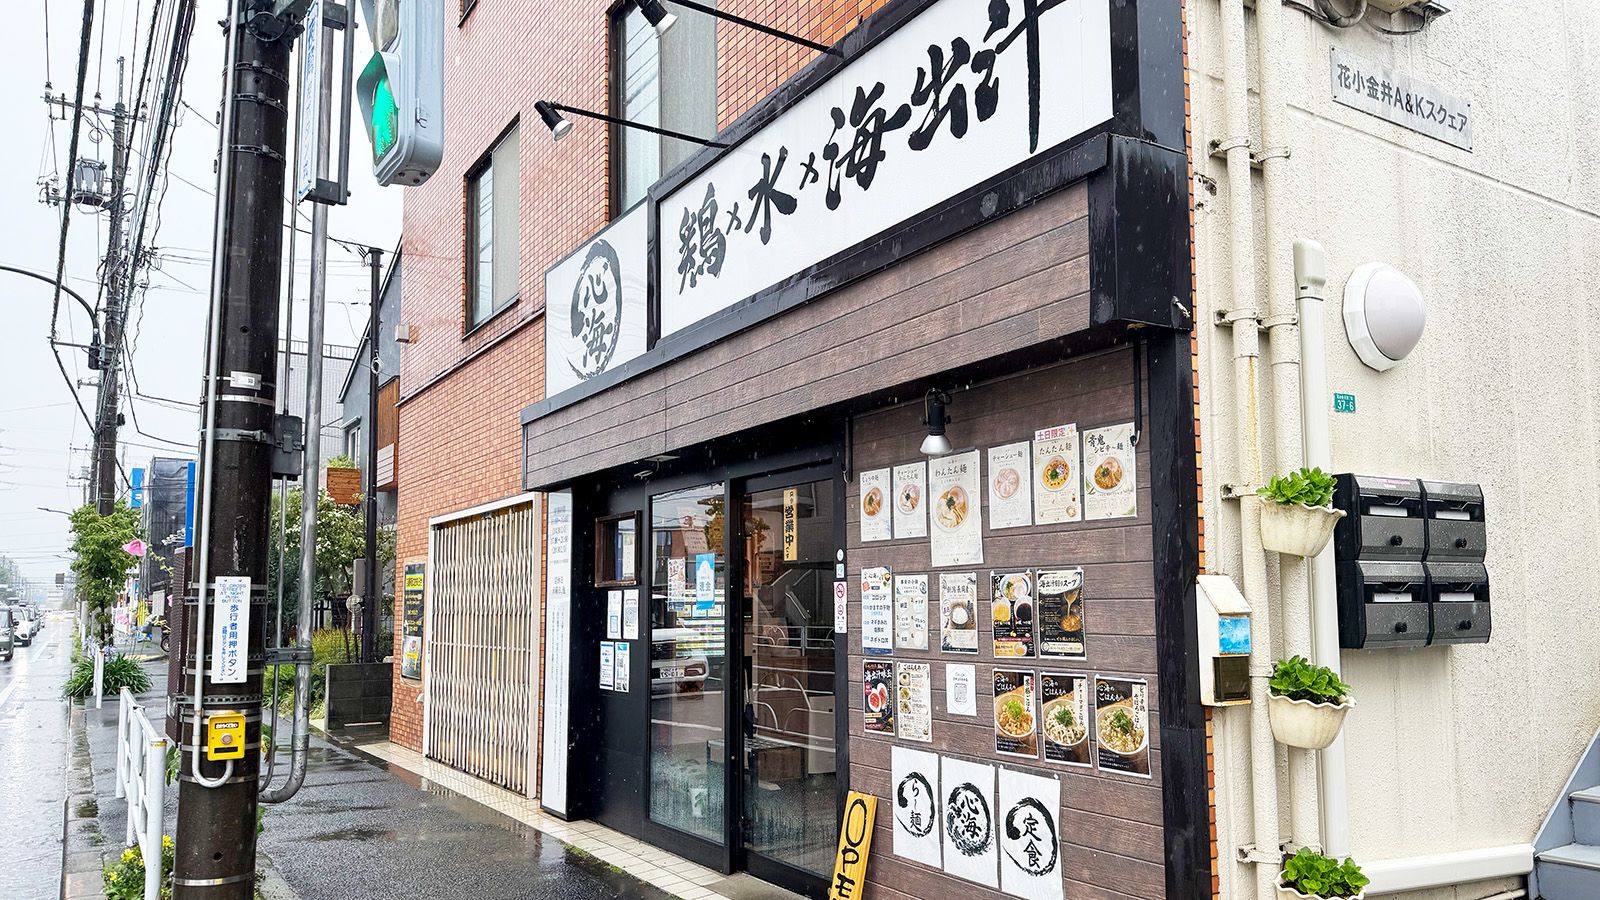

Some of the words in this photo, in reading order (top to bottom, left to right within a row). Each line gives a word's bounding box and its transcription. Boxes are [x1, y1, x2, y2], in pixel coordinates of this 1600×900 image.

[1337, 400, 1355, 411] 37-6
[1037, 427, 1066, 441] 土日限定
[935, 463, 969, 477] わんたん麺
[228, 604, 239, 677] 歩行者用押ボタン
[959, 794, 983, 839] 心海
[834, 799, 868, 900] OPE
[1022, 812, 1043, 870] 定食
